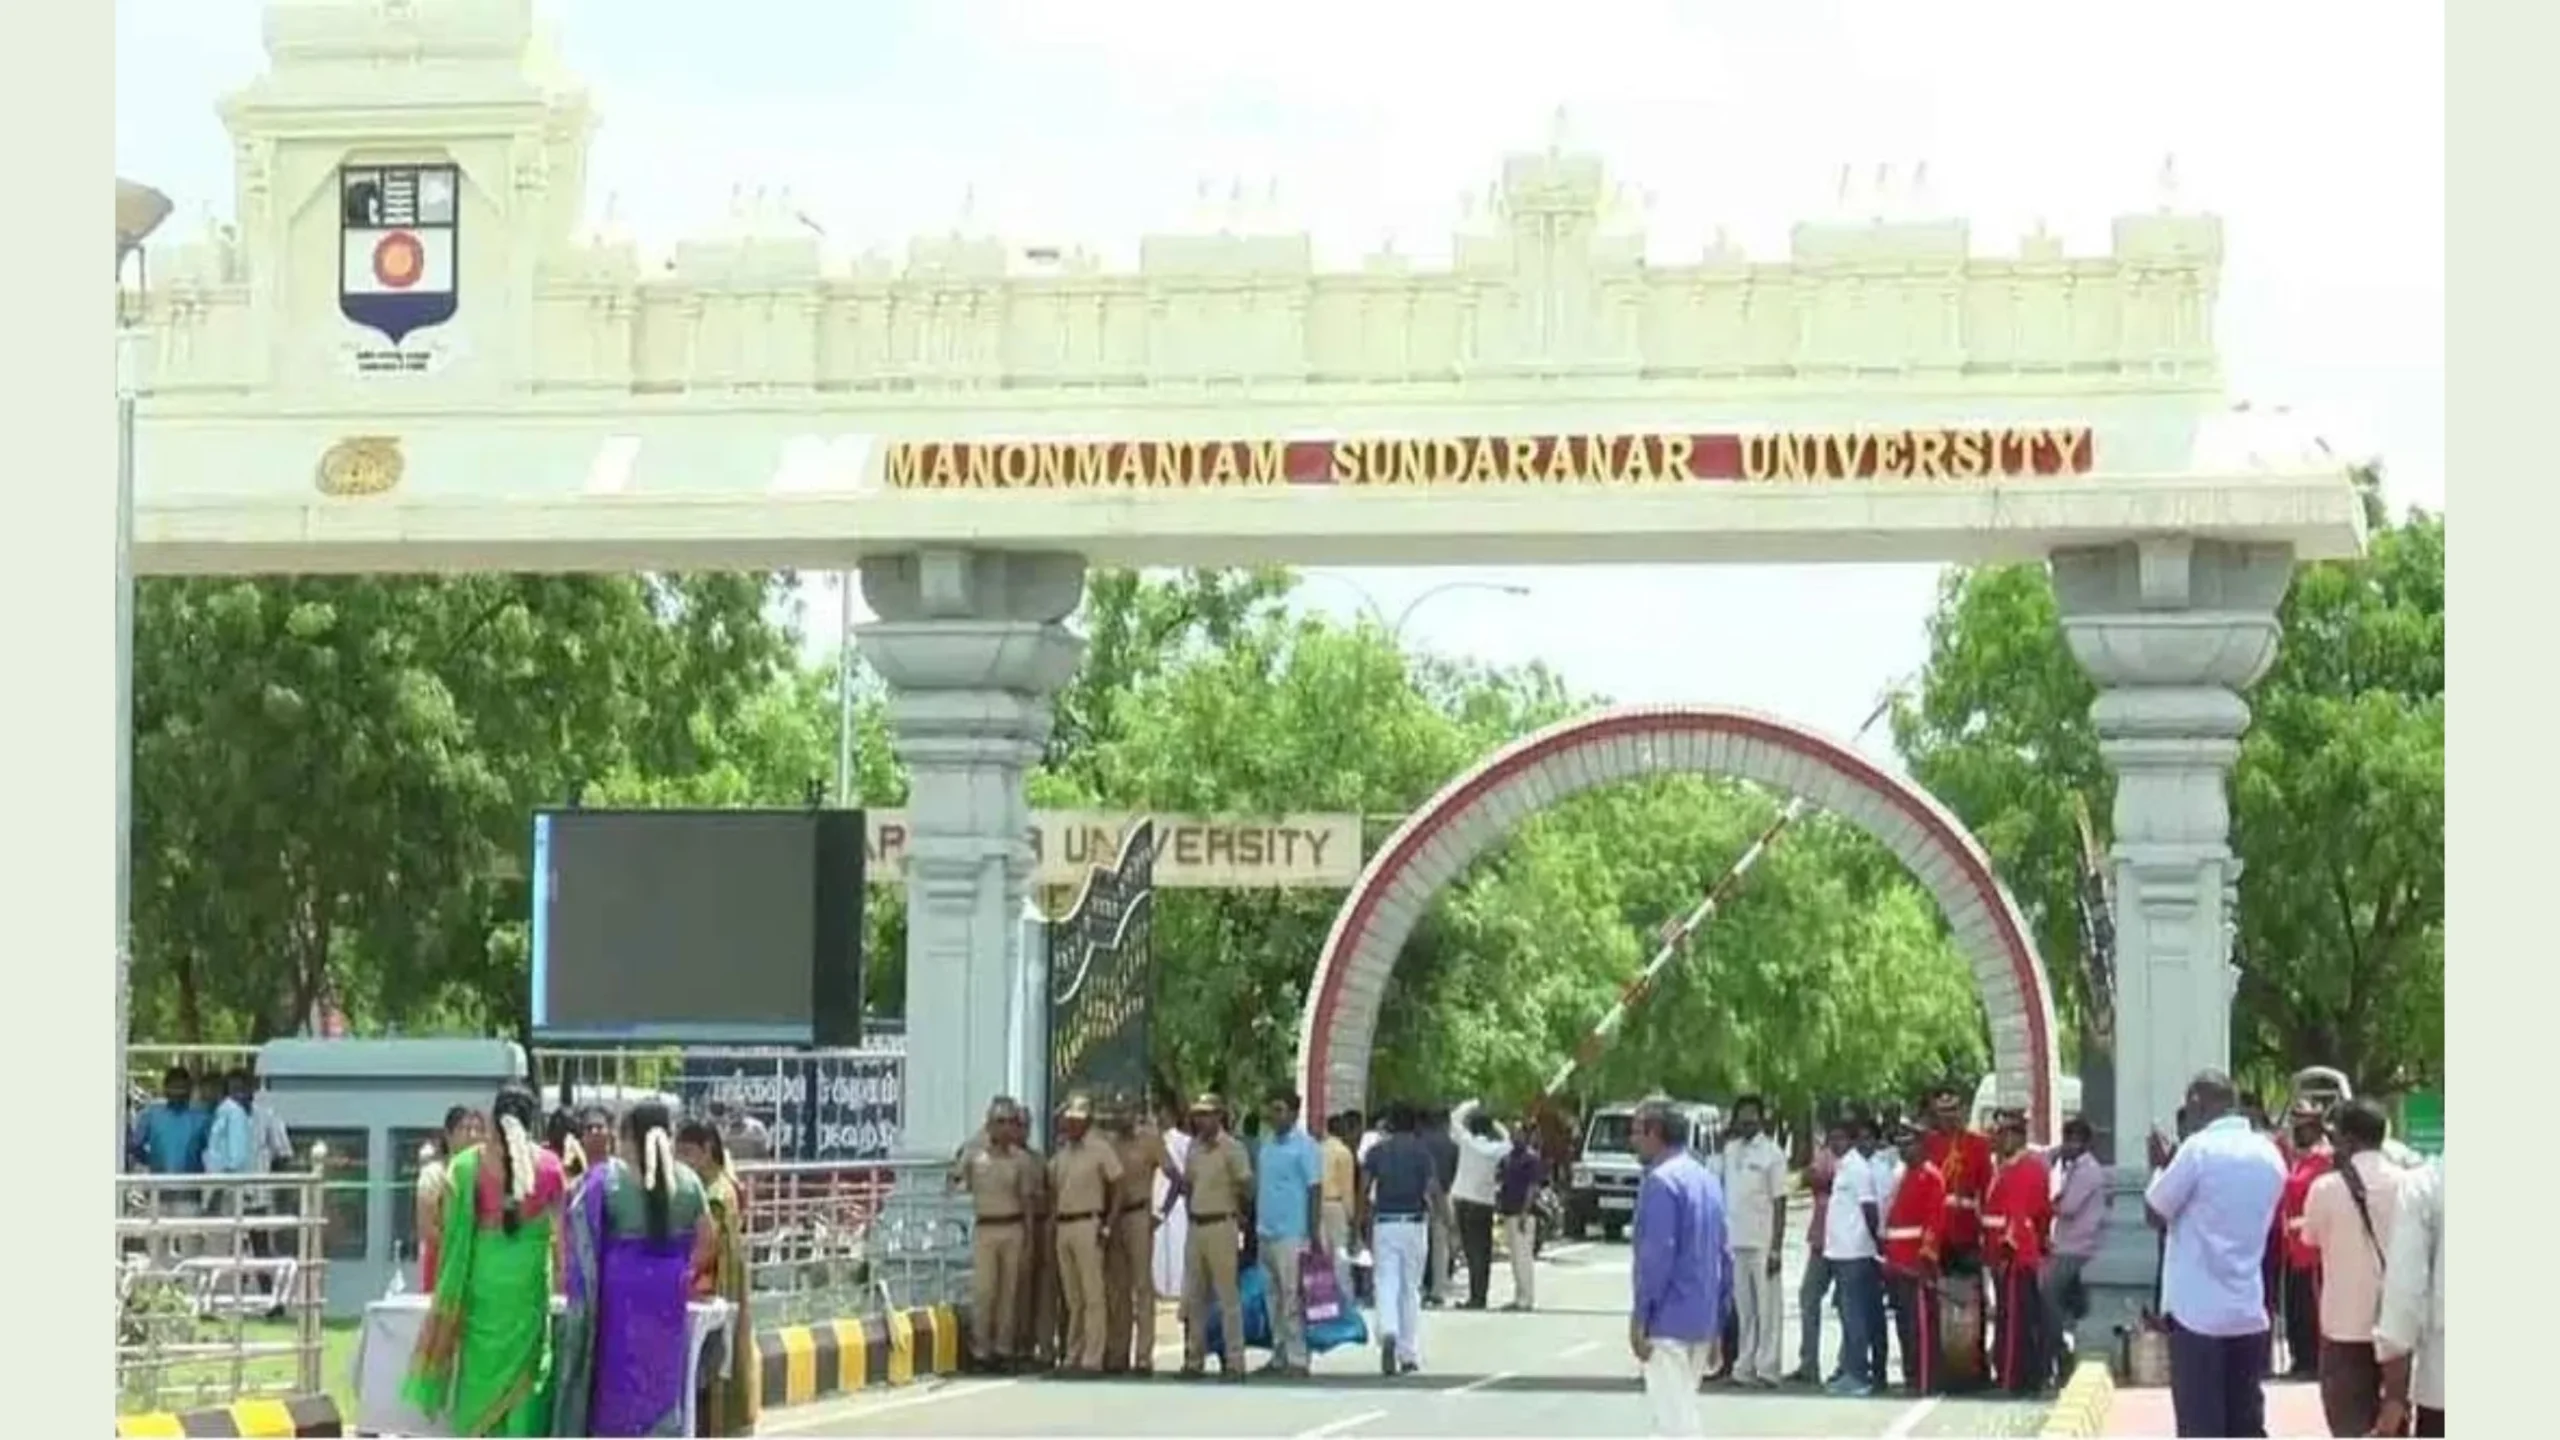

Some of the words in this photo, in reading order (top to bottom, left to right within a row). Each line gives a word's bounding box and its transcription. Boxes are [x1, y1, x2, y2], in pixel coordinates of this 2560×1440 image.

[885, 440, 1286, 488] MANONMANIAM
[1330, 435, 1694, 486] SUNDARANAR
[1740, 428, 2090, 482] UNIVERSITY
[1065, 825, 1331, 867] UNVERSITY
